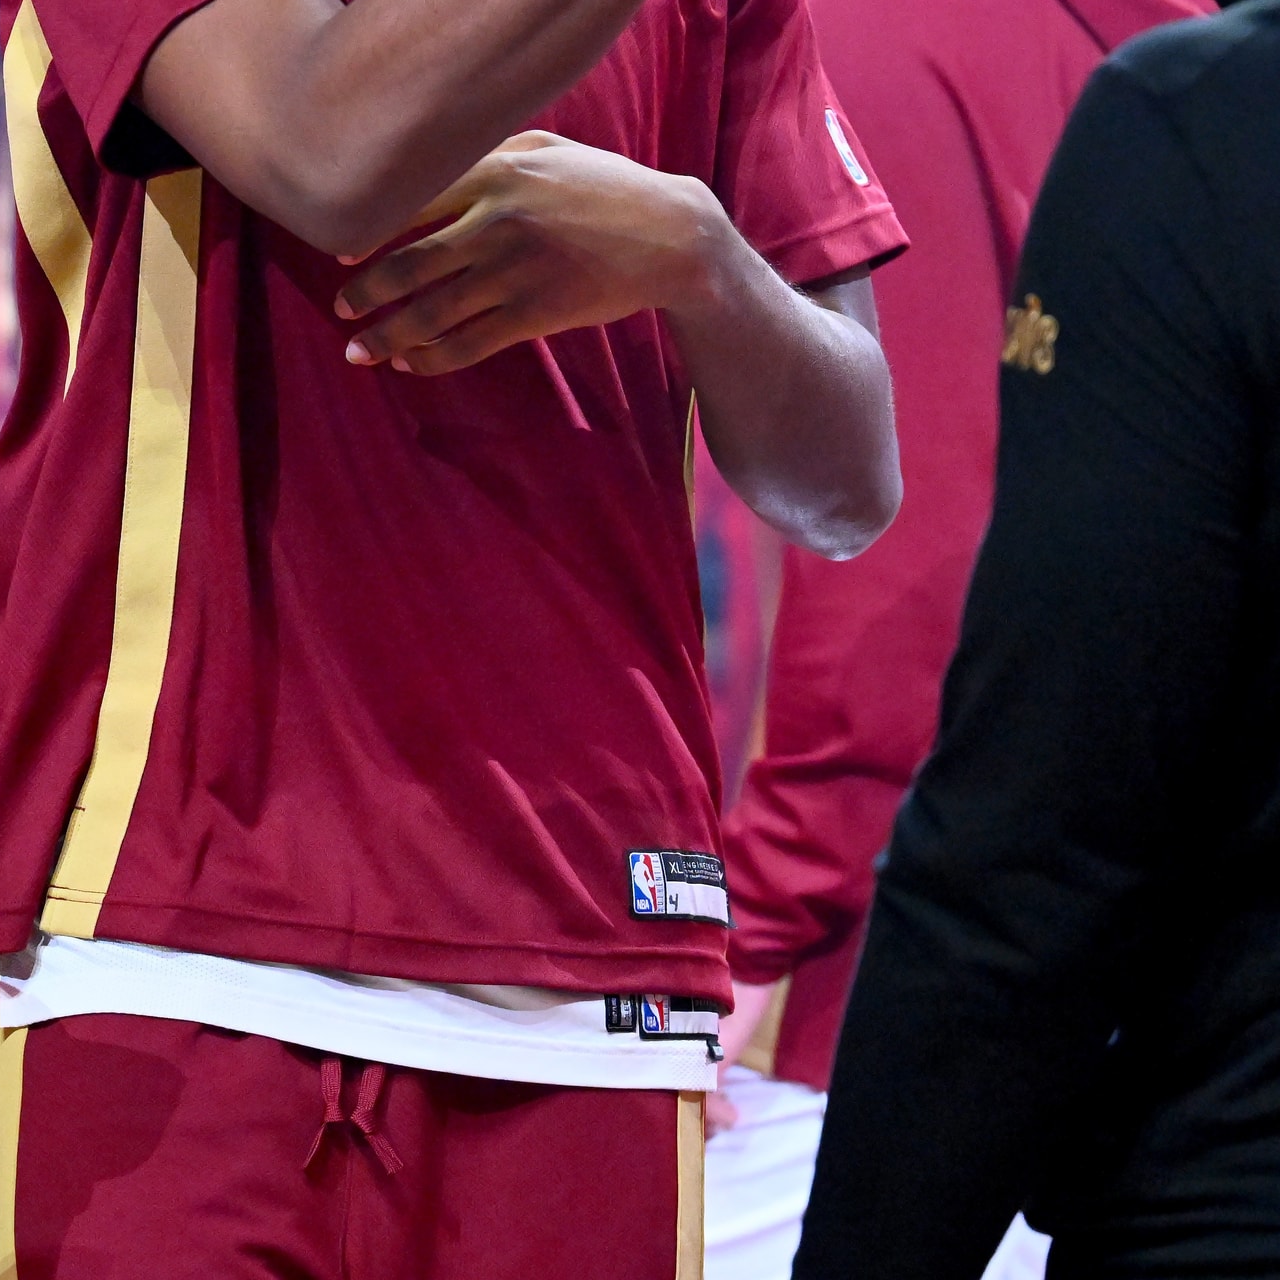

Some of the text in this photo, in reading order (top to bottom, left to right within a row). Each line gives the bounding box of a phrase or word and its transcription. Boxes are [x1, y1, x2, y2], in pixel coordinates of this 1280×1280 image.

[669, 861, 683, 875] XL
[636, 898, 650, 911] NBA
[669, 893, 679, 912] 4
